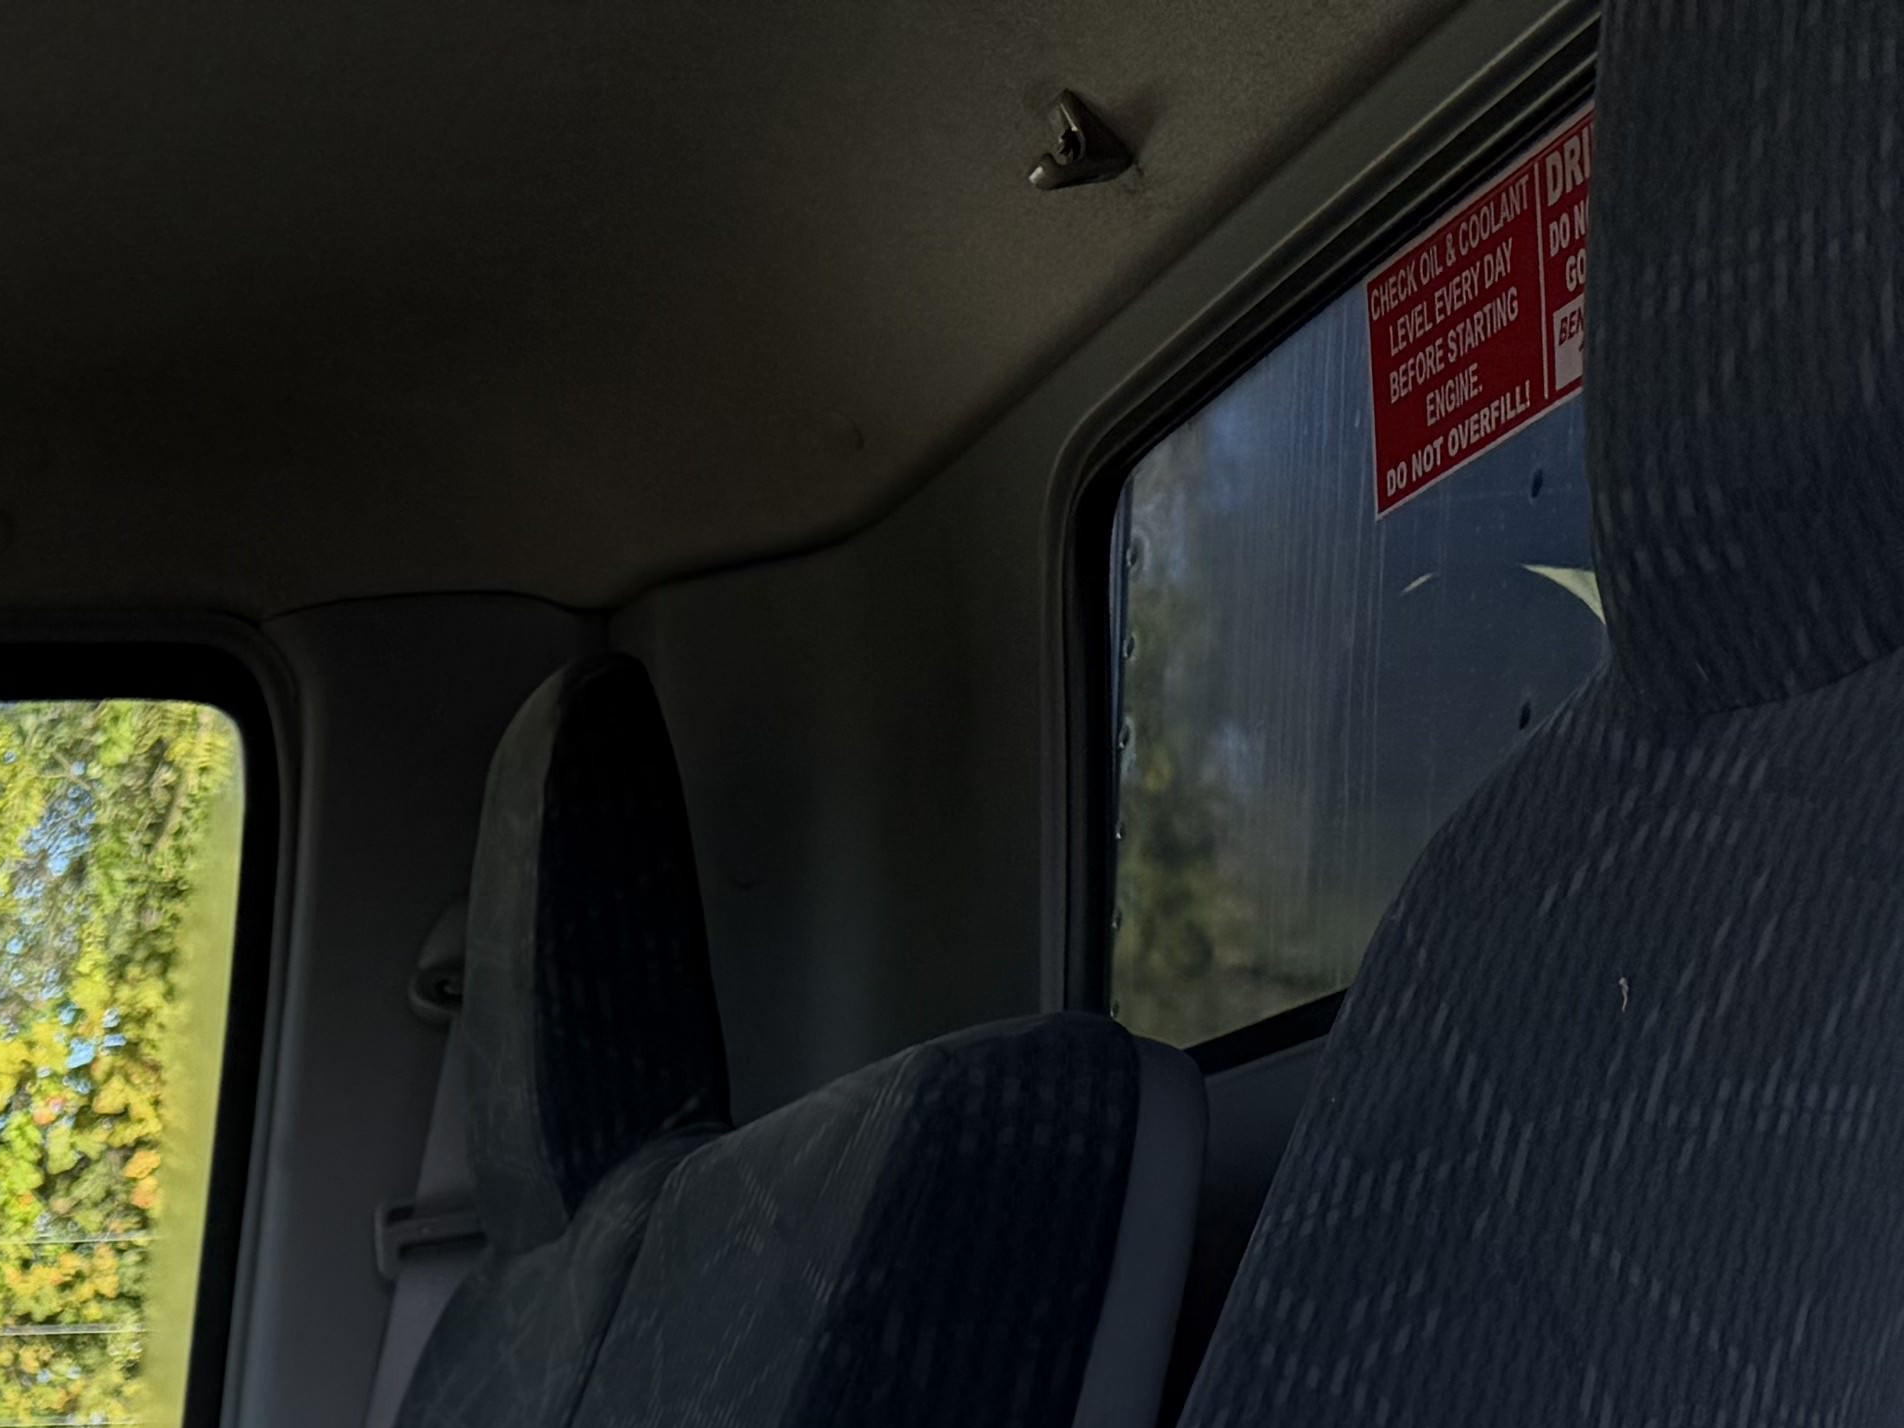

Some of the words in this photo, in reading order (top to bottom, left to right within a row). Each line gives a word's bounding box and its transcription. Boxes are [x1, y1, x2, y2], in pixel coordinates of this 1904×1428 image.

[1369, 259, 1418, 321] CHECK
[1418, 244, 1443, 286] OIL
[1445, 232, 1457, 267] &
[1458, 173, 1529, 256] COOLANT
[1549, 212, 1570, 257] DO
[1574, 197, 1589, 240] N
[1388, 299, 1433, 357] LEVEL
[1433, 260, 1481, 324] EVERY
[1482, 236, 1513, 289] DAY
[1388, 336, 1445, 404] BEFORE
[1446, 285, 1519, 363] STARTING
[1385, 460, 1407, 497] DO
[1410, 435, 1444, 482] NOT
[1446, 378, 1531, 457] OVERFILL!
[1425, 361, 1483, 427] ENGINE.
